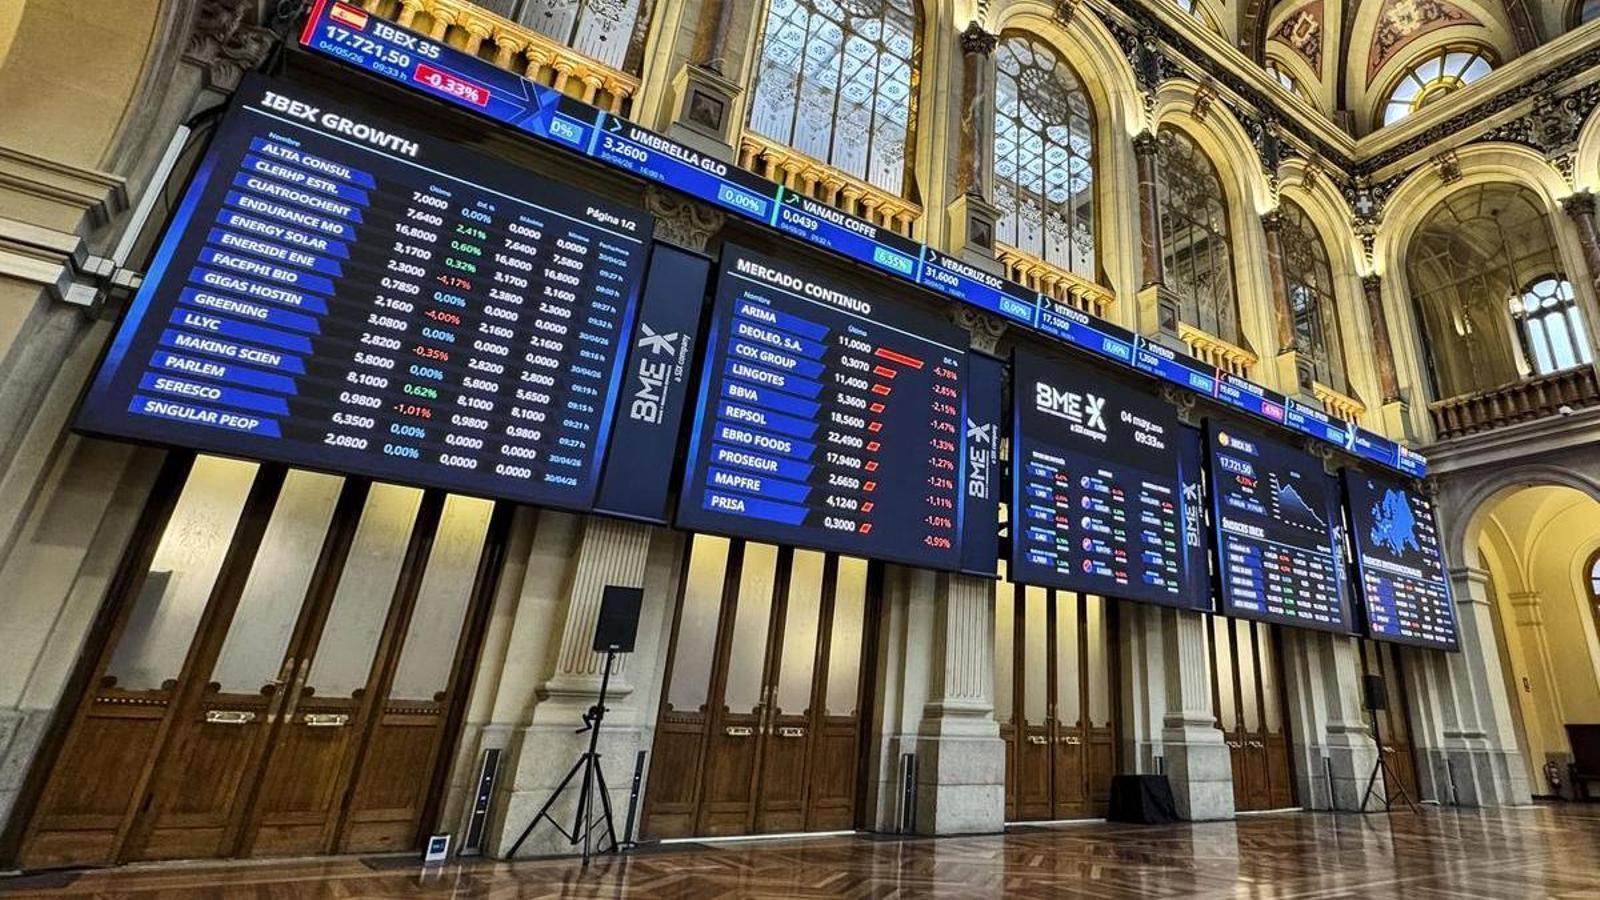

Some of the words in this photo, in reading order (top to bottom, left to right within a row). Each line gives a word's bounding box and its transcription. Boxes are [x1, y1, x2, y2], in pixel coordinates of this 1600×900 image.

[319, 40, 364, 64] 04/05/26
[327, 25, 410, 68] 17.721,50
[372, 22, 418, 50] IBEX
[416, 41, 441, 59] 35
[425, 73, 479, 103] -0,33%
[261, 91, 320, 123] IBEX
[321, 113, 419, 157] GROWTH
[603, 136, 648, 162] 3,2600
[630, 128, 700, 166] UMBRELLA
[700, 158, 727, 177] GLO
[255, 160, 306, 182] CLERHP
[306, 176, 339, 194] ESTR.
[407, 207, 443, 226] 7,6400
[456, 224, 487, 240] 2,41%
[504, 238, 537, 256] 7,6400
[553, 253, 584, 270] 7,5800
[262, 143, 300, 162] ALTIA
[301, 156, 351, 179] CONSUL
[413, 191, 449, 210] 7,0000
[461, 207, 492, 224] 0,00%
[508, 223, 542, 240] 0,0000
[556, 238, 588, 255] 0,0000
[586, 206, 620, 225] Página
[621, 219, 636, 231] 1/2
[725, 189, 759, 211] 0,00%
[783, 209, 818, 231] 0,0439
[803, 199, 845, 226] VANADI
[844, 218, 877, 238] COFFE
[238, 196, 321, 228] ENDURANCE
[320, 220, 344, 234] MO
[393, 241, 432, 260] 3,1700
[445, 257, 477, 273] 0,32%
[494, 271, 528, 288] 3,1700
[543, 286, 576, 302] 3,1600
[247, 178, 351, 216] CUATROOCHENT
[395, 223, 438, 243] 16,8000
[451, 240, 482, 256] 0,60%
[495, 253, 533, 272] 16,8000
[544, 268, 580, 286] 16,8000
[221, 233, 288, 259] ENERSIDE
[288, 251, 315, 267] ENE
[381, 277, 420, 295] 0,7850
[433, 291, 466, 308] 0,00%
[483, 305, 519, 322] 0,0000
[534, 319, 568, 335] 0,0000
[229, 215, 285, 237] ENERGY
[284, 230, 328, 250] SOLAR
[387, 259, 426, 278] 2,3000
[436, 275, 471, 290] -4,17%
[489, 288, 524, 305] 2,3800
[539, 302, 572, 319] 2,3000
[737, 258, 803, 291] MERCADO
[804, 282, 871, 315] CONTINUO
[925, 266, 959, 287] 31,6000
[941, 257, 986, 283] VERACRUZ
[985, 275, 1003, 290] SOC
[204, 273, 249, 292] GIGAS
[249, 284, 303, 305] HOSTIN
[367, 313, 408, 331] 3,0800
[422, 327, 455, 343] 0,00%
[473, 339, 509, 356] 0,0000
[525, 352, 559, 369] 0,0000
[212, 252, 272, 276] FACEPHI
[271, 268, 298, 283] BIO
[374, 295, 414, 313] 2,1600
[425, 310, 461, 325] -4,00%
[478, 322, 514, 339] 2,1600
[530, 335, 564, 352] 2,1600
[194, 293, 269, 319] GREENING
[360, 332, 401, 350] 2,8200
[412, 345, 449, 361] -0,35%
[468, 358, 504, 375] 2,8200
[520, 370, 555, 387] 2,8000
[738, 323, 783, 347] DEOLEO,
[783, 337, 803, 352] S.A.
[841, 355, 870, 372] 0,3070
[741, 304, 777, 323] ARIMA
[839, 335, 872, 354] 11,0000
[175, 334, 238, 356] MAKING
[238, 348, 281, 366] SCIEN
[346, 371, 389, 389] 8,1000
[403, 383, 438, 399] 0,62%
[456, 395, 494, 411] 8,1000
[511, 406, 546, 422] 8,1000
[184, 313, 221, 330] LLYC
[353, 352, 395, 369] 5,8000
[409, 364, 444, 381] 0,00%
[462, 376, 499, 393] 5,8000
[515, 388, 550, 405] 5,6500
[735, 343, 759, 359] COX
[759, 350, 797, 369] GROUP
[835, 372, 869, 390] 11,4000
[165, 356, 226, 377] PARLEM
[339, 391, 382, 409] 0,9800
[393, 403, 432, 418] -1,01%
[451, 414, 489, 430] 0,9800
[505, 425, 541, 441] 0,9800
[630, 358, 665, 423] BME
[728, 384, 758, 401] BBVA
[831, 411, 865, 429] 18,5600
[732, 363, 785, 386] LINGOTES
[837, 392, 867, 409] 5,3600
[1036, 382, 1082, 418] BME
[144, 400, 218, 423] SNGULAR
[219, 414, 259, 430] PEOP
[324, 432, 368, 450] 2,0800
[383, 443, 419, 459] 0,00%
[439, 453, 478, 469] 0,0000
[495, 463, 532, 479] 0,0000
[154, 378, 221, 400] SERESCO
[332, 412, 375, 429] 6,3500
[390, 423, 426, 439] 0,00%
[445, 433, 484, 450] 0,0000
[500, 444, 537, 460] 0,0000
[725, 405, 767, 425] REPSOL
[828, 431, 863, 449] 22,4900
[718, 449, 778, 472] PROSEGUR
[828, 473, 860, 490] 2,6650
[722, 427, 753, 444] EBRO
[754, 435, 791, 453] FOODS
[826, 452, 862, 469] 17,9400
[968, 446, 986, 499] BME
[711, 495, 745, 512] PRISA
[824, 516, 856, 532] 0,3000
[714, 472, 761, 491] MAPFRE
[826, 495, 858, 510] 4,1240
